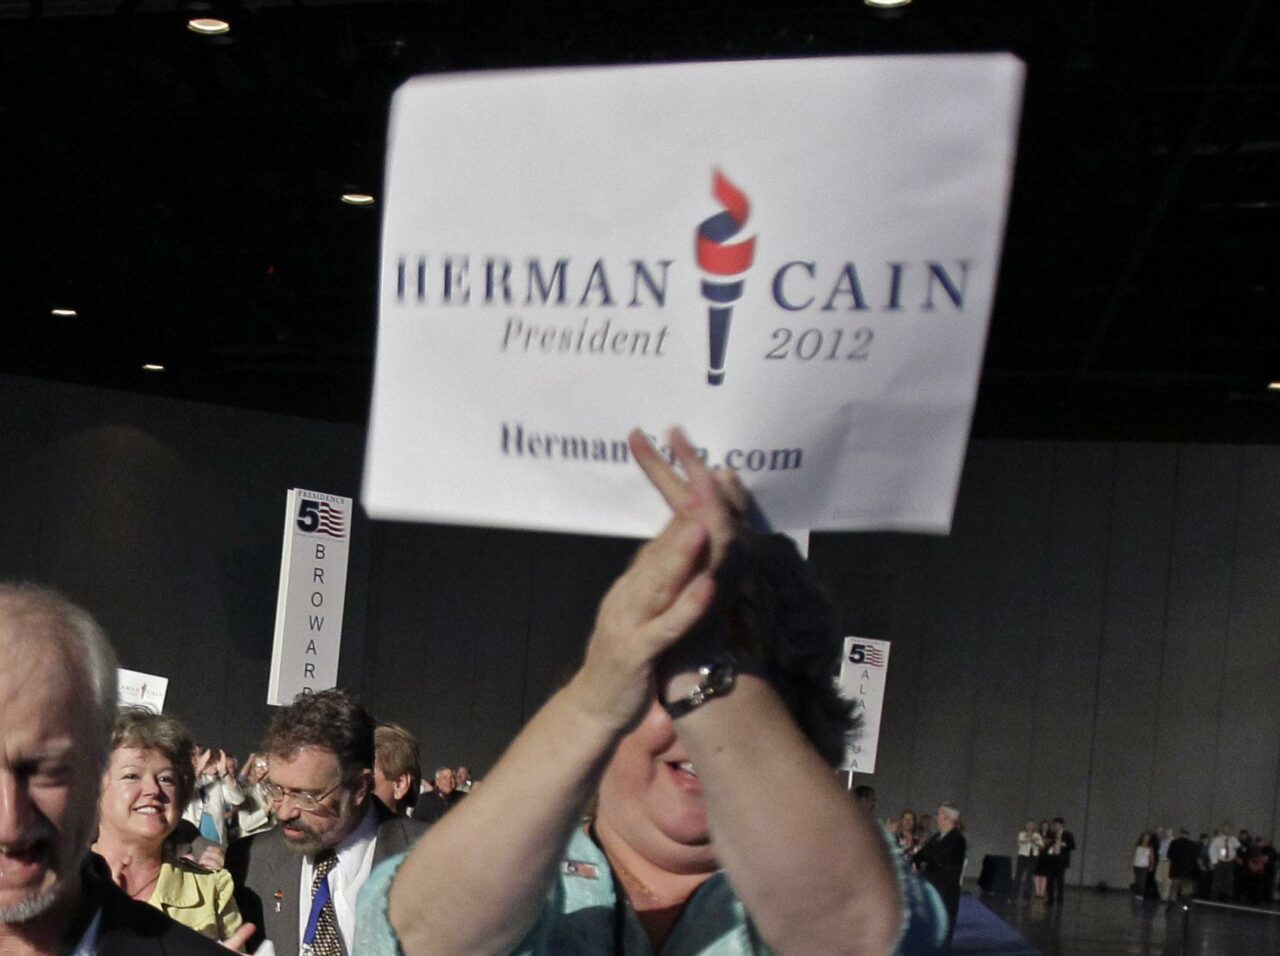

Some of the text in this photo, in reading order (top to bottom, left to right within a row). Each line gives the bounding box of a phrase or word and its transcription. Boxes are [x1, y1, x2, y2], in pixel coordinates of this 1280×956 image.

[397, 257, 974, 312] HERMAN CAIN
[500, 315, 874, 361] President 2012
[297, 499, 320, 533] 5
[849, 644, 866, 664] 5
